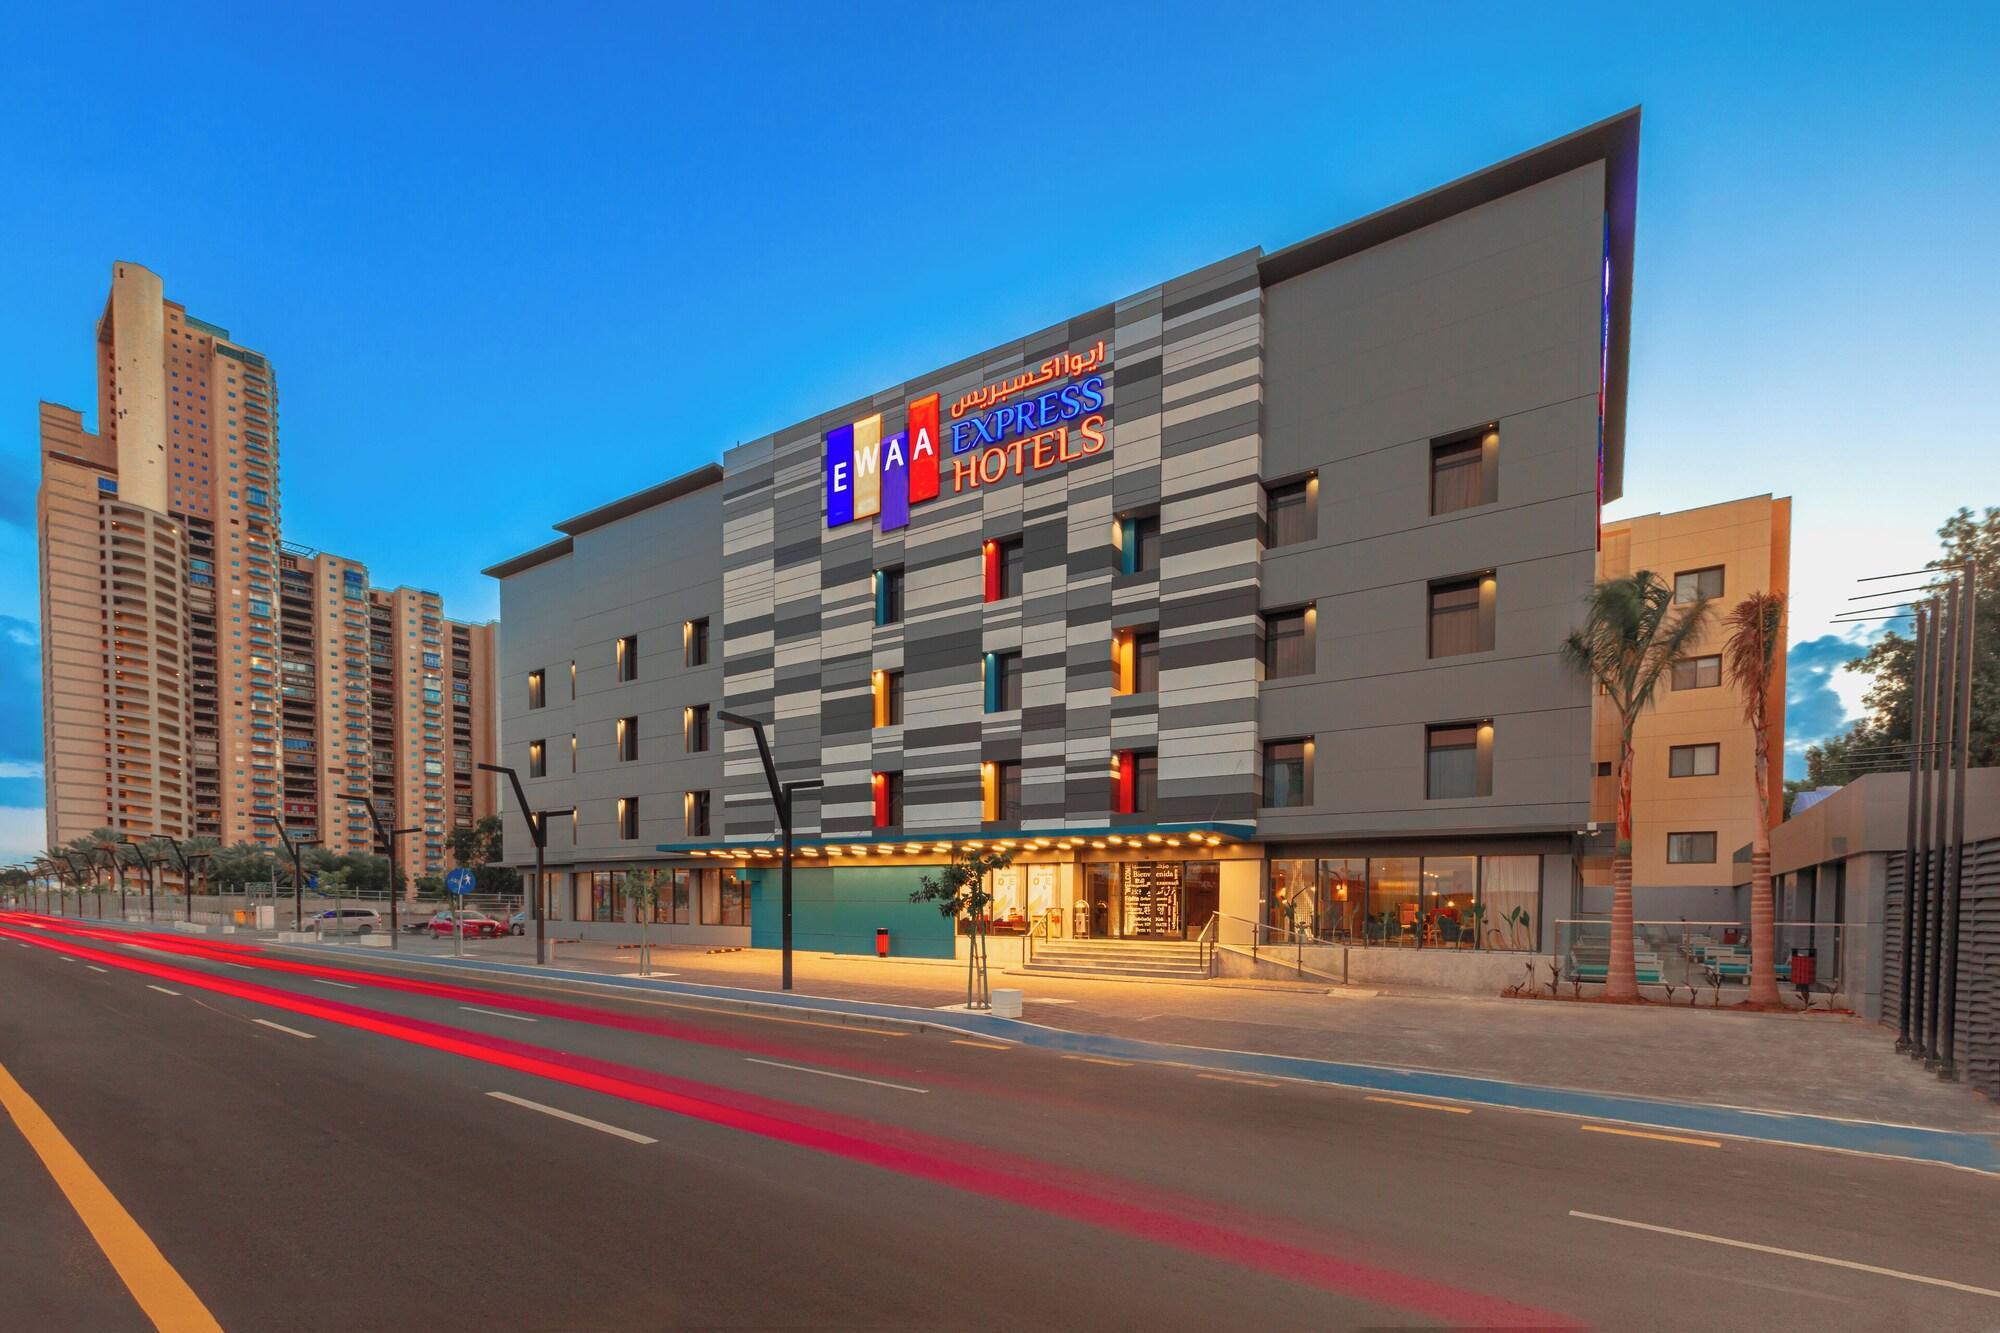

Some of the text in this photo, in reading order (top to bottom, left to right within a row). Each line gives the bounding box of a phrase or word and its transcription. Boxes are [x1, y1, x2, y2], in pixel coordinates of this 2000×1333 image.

[951, 376, 1104, 455] EXPRESS
[952, 415, 1105, 492] HOTELS
[833, 427, 934, 493] EWAA
